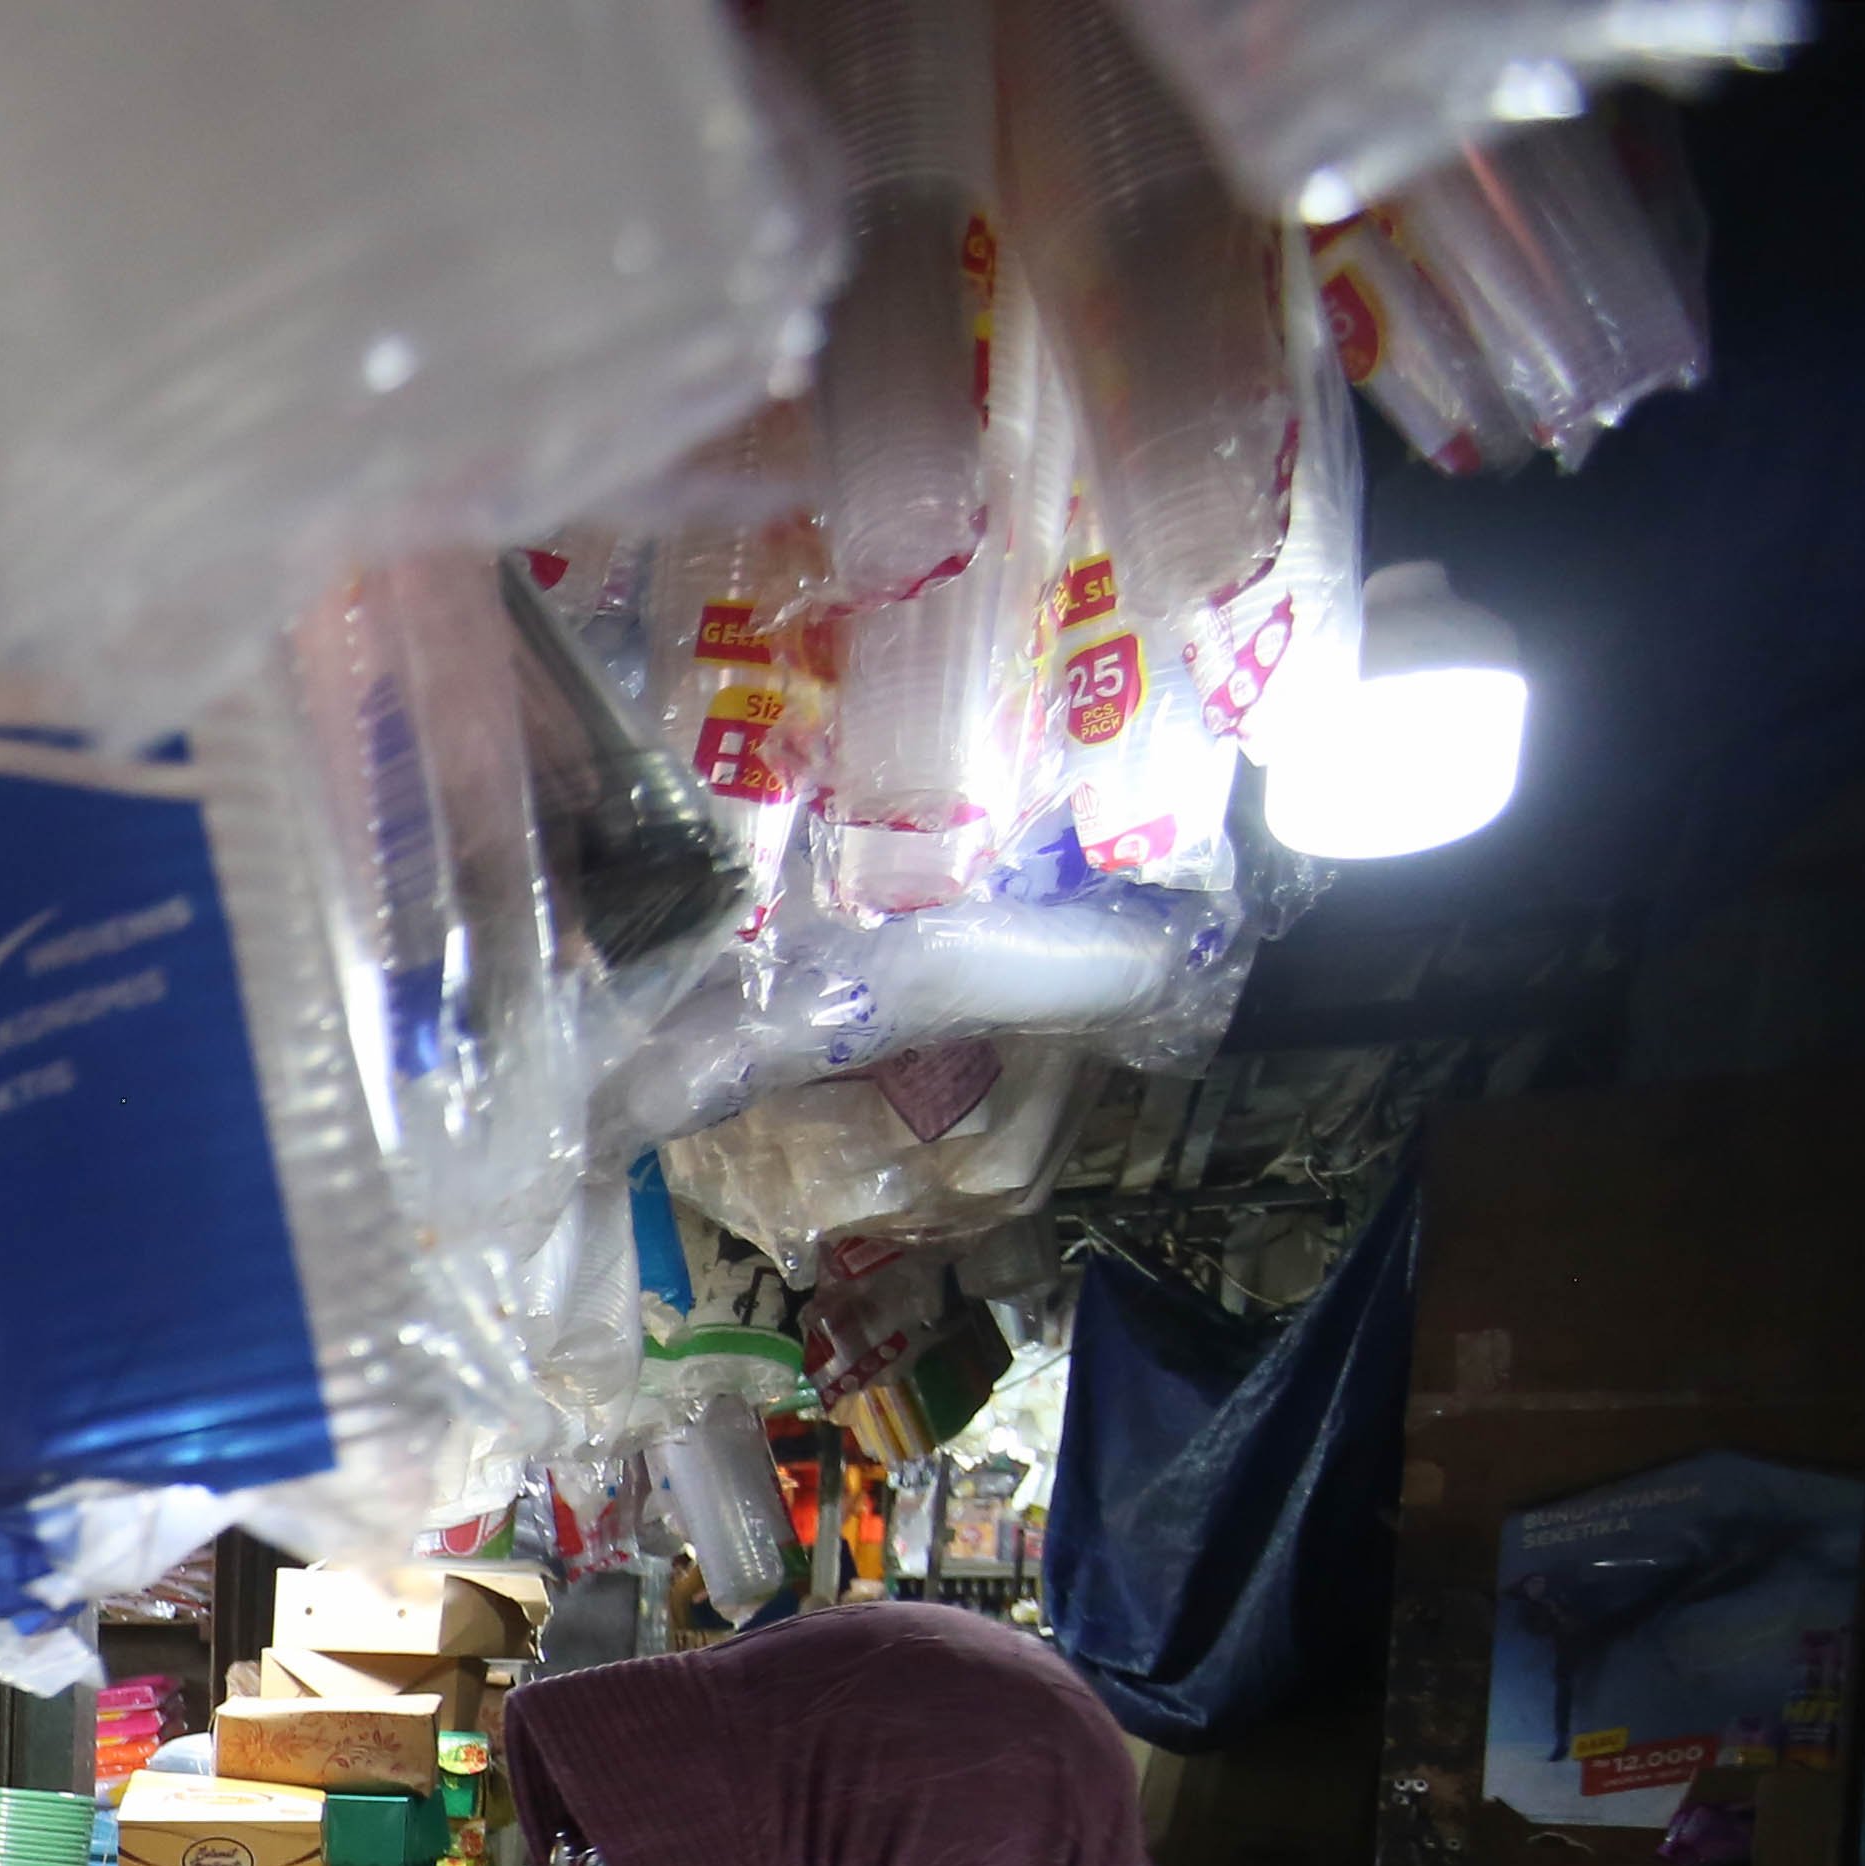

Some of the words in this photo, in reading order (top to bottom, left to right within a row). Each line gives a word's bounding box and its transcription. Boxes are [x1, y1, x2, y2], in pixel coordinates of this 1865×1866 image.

[1070, 653, 1126, 709] 25
[746, 692, 784, 720] Siz
[1081, 704, 1114, 723] PCS
[1080, 716, 1121, 741] PACK
[1523, 1515, 1632, 1549] SEKETIKA
[1613, 1744, 1705, 1775] 12.000
